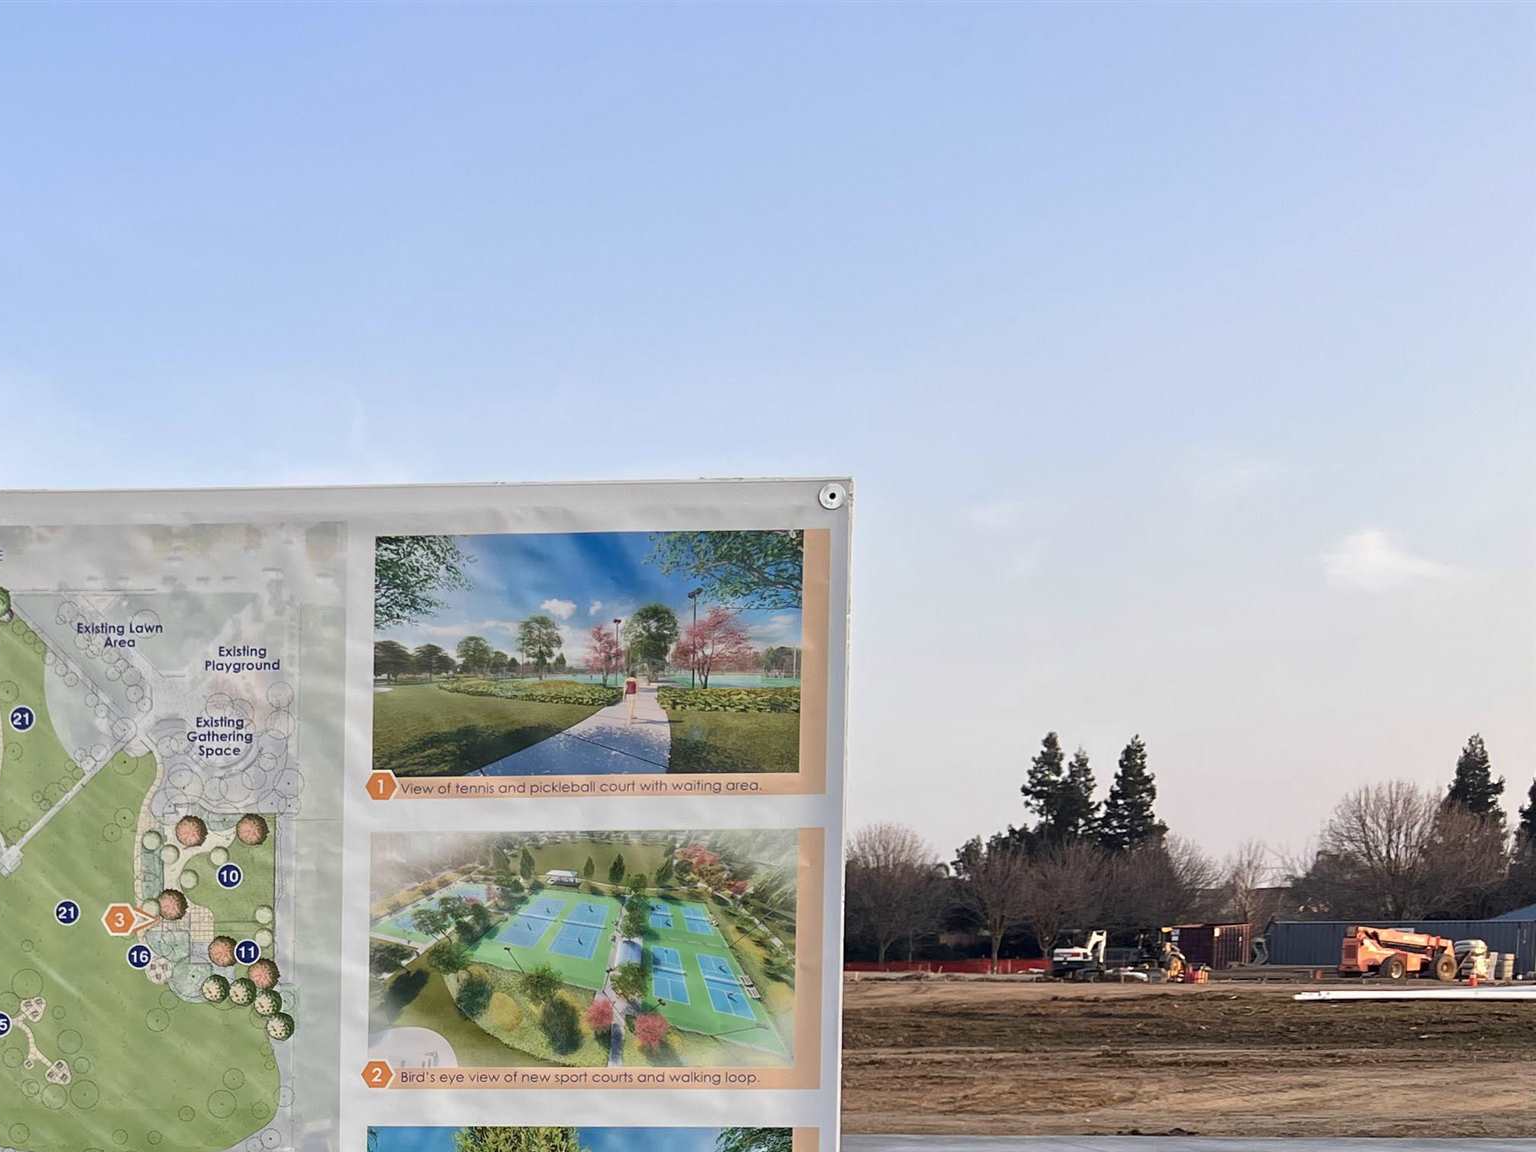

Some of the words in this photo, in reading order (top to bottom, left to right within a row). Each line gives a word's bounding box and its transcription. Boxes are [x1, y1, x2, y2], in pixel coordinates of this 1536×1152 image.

[77, 623, 124, 635] Existing
[129, 623, 163, 634] Lawn
[104, 637, 136, 647] Area
[219, 647, 267, 658] Existing
[205, 660, 280, 673] Playground
[196, 717, 244, 729] Existing
[187, 731, 253, 743] Gathering
[198, 746, 241, 757] Space
[401, 783, 434, 793] View
[439, 782, 451, 793] of
[455, 782, 495, 793] tennis
[499, 781, 525, 793] and
[530, 781, 595, 796] pickleball
[600, 781, 635, 793] court
[640, 780, 667, 792] with
[672, 780, 721, 794] waiting
[726, 781, 762, 792] area.
[400, 1072, 434, 1083] Bird's
[440, 1074, 464, 1086] eye
[468, 1073, 499, 1083] view
[504, 1072, 518, 1083] of
[521, 1074, 550, 1083] new
[555, 1072, 587, 1085] sport
[592, 1072, 632, 1083] courts
[637, 1072, 664, 1083] and
[670, 1072, 721, 1085] walking
[725, 1072, 760, 1085] loop.
